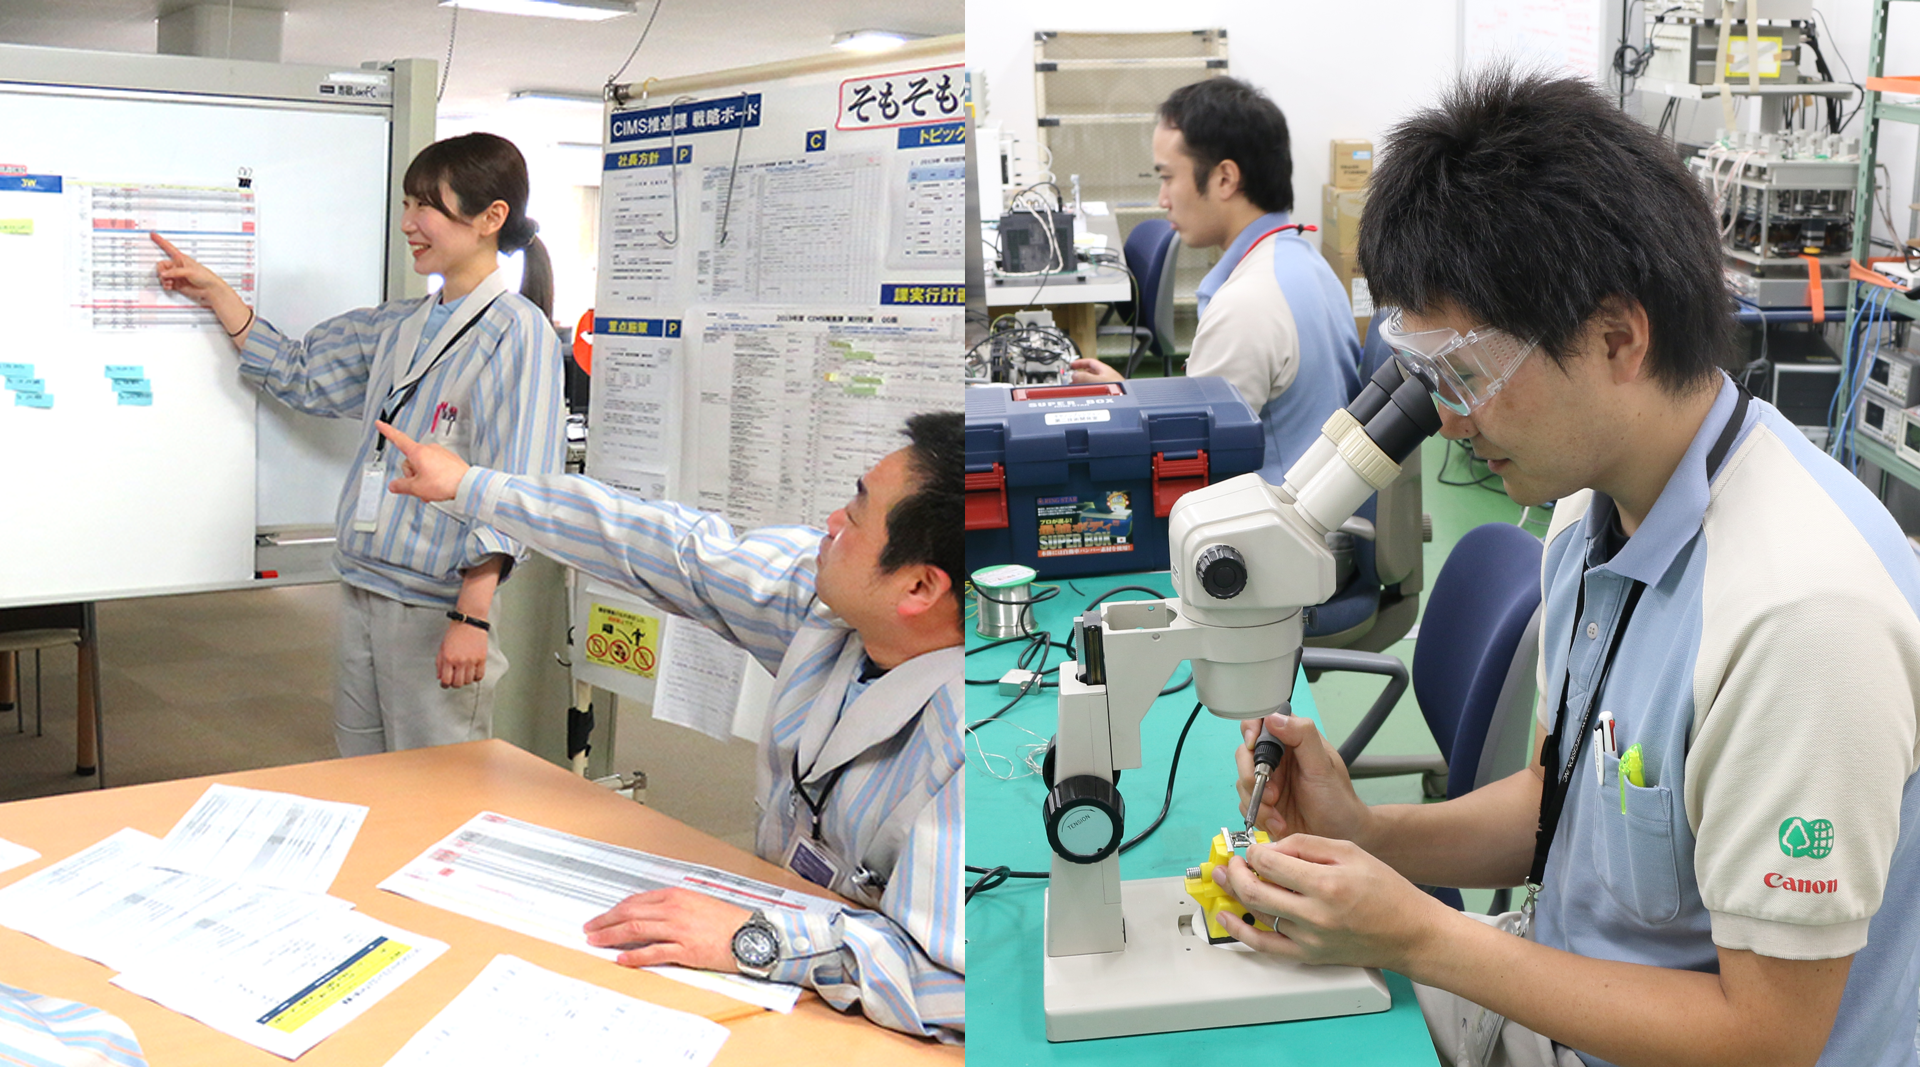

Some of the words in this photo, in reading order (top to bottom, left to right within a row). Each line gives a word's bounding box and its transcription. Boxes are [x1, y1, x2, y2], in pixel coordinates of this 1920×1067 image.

[848, 74, 965, 122] そもそも
[612, 114, 688, 137] CIMS推進課
[692, 102, 759, 128] 戦略ボード
[810, 134, 822, 148] C
[617, 152, 660, 168] 社長方針
[679, 148, 689, 161] P
[669, 322, 678, 335] P
[1028, 400, 1076, 408] SUPER
[1039, 533, 1083, 551] SUPER
[1084, 531, 1112, 548] BOX
[1067, 814, 1091, 831] TENSION
[1764, 872, 1838, 894] Canon
